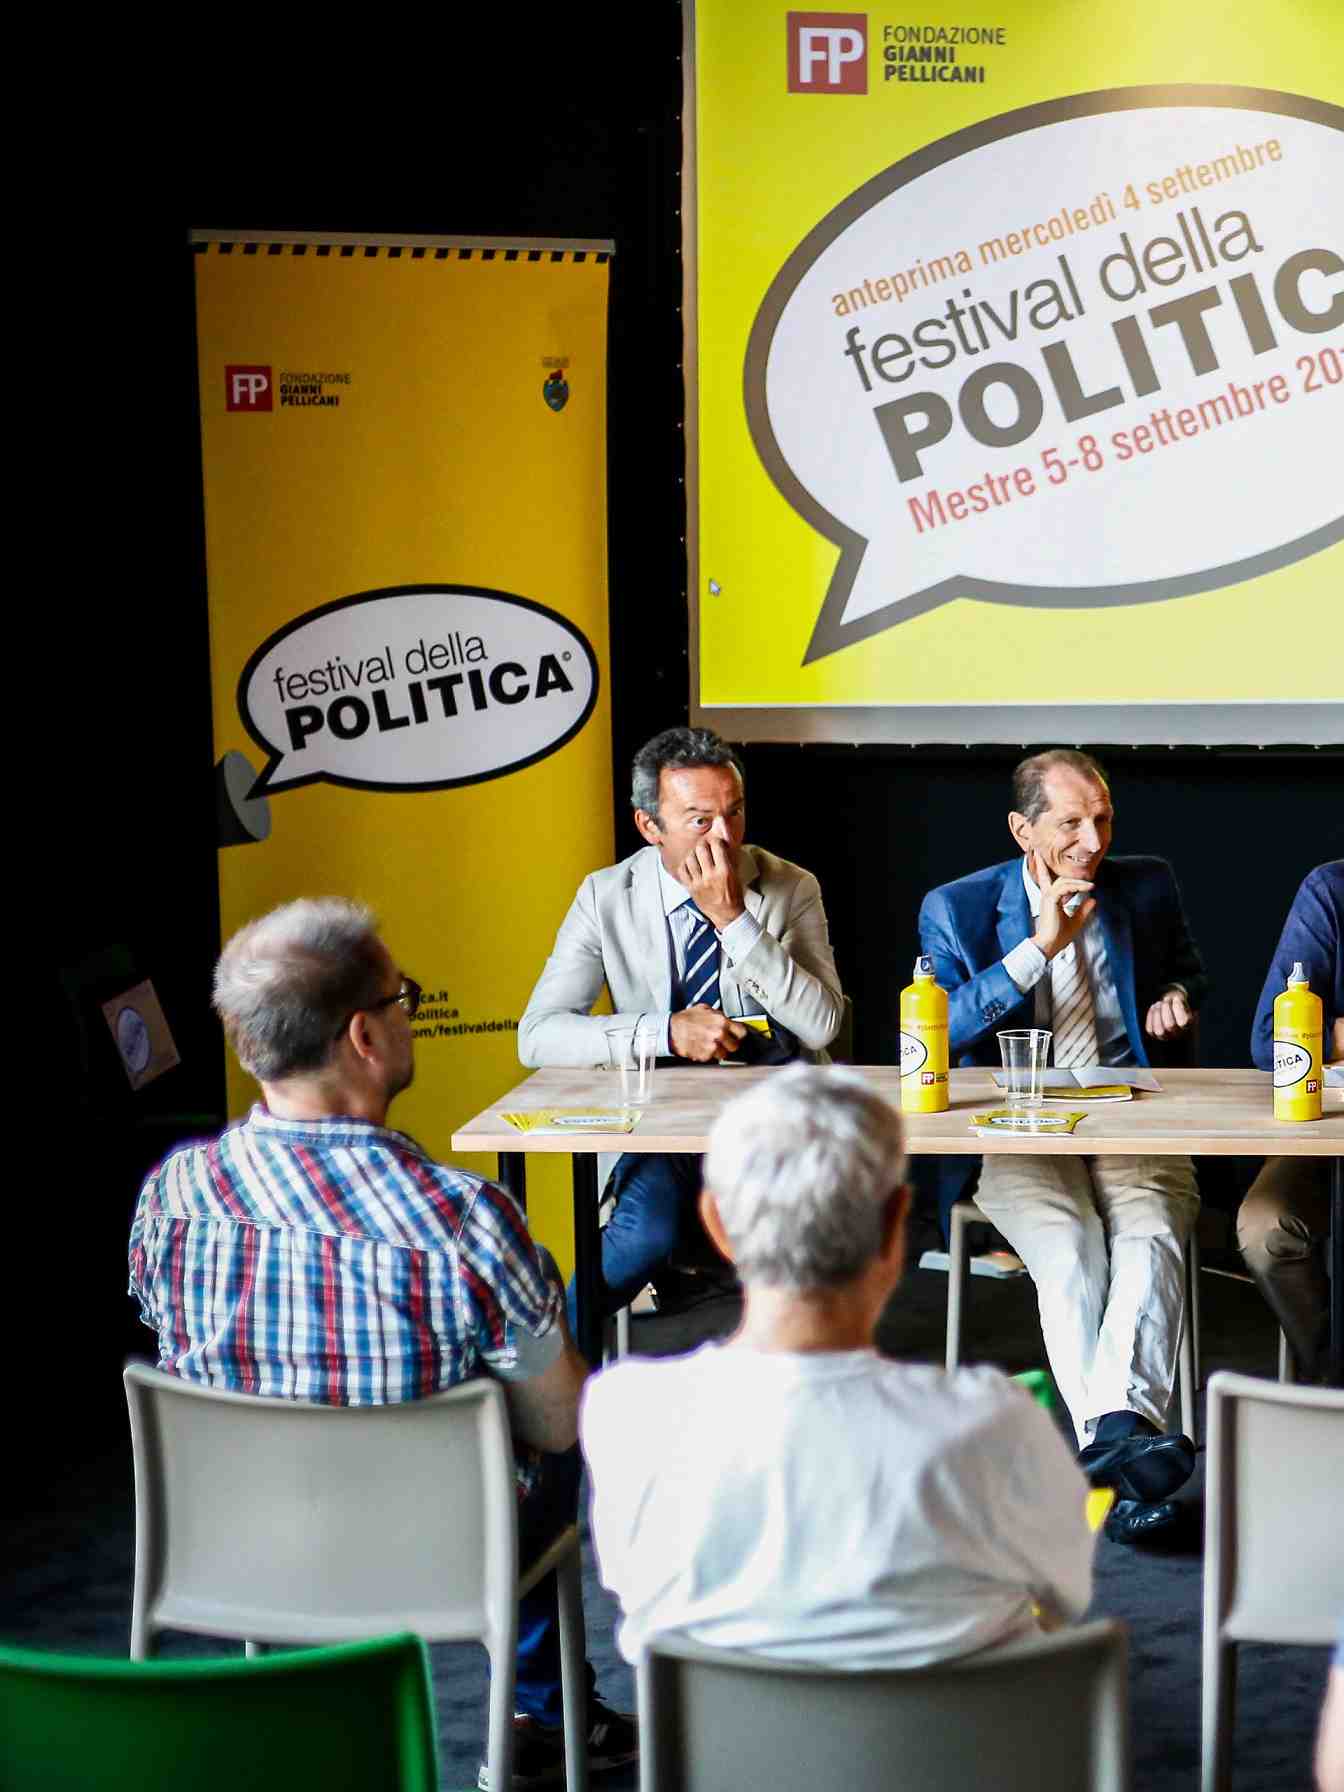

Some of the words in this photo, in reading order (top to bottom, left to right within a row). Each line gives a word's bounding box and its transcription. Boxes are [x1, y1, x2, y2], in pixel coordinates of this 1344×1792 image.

[883, 25, 1006, 46] FONDAZIONE
[799, 27, 866, 84] FP
[883, 46, 955, 64] GIANNI
[883, 64, 985, 84] PELLICANI
[832, 249, 973, 318] anteprima
[978, 191, 1118, 268] mercoledì
[1121, 179, 1142, 211] 4
[1147, 137, 1284, 205] settembre
[843, 254, 1086, 392] festival
[1099, 205, 1264, 303] della
[231, 372, 269, 404] FP
[280, 373, 352, 385] FONDAZIONE
[280, 384, 322, 395] GIANNI
[281, 395, 339, 406] PELLICANI
[907, 457, 1037, 533] Mestre
[1042, 434, 1106, 485] 5-8
[1110, 373, 1291, 463] settembre
[273, 646, 395, 703] festival
[405, 631, 488, 676] della
[285, 653, 574, 751] POLITICA
[1277, 1054, 1304, 1069] TICA
